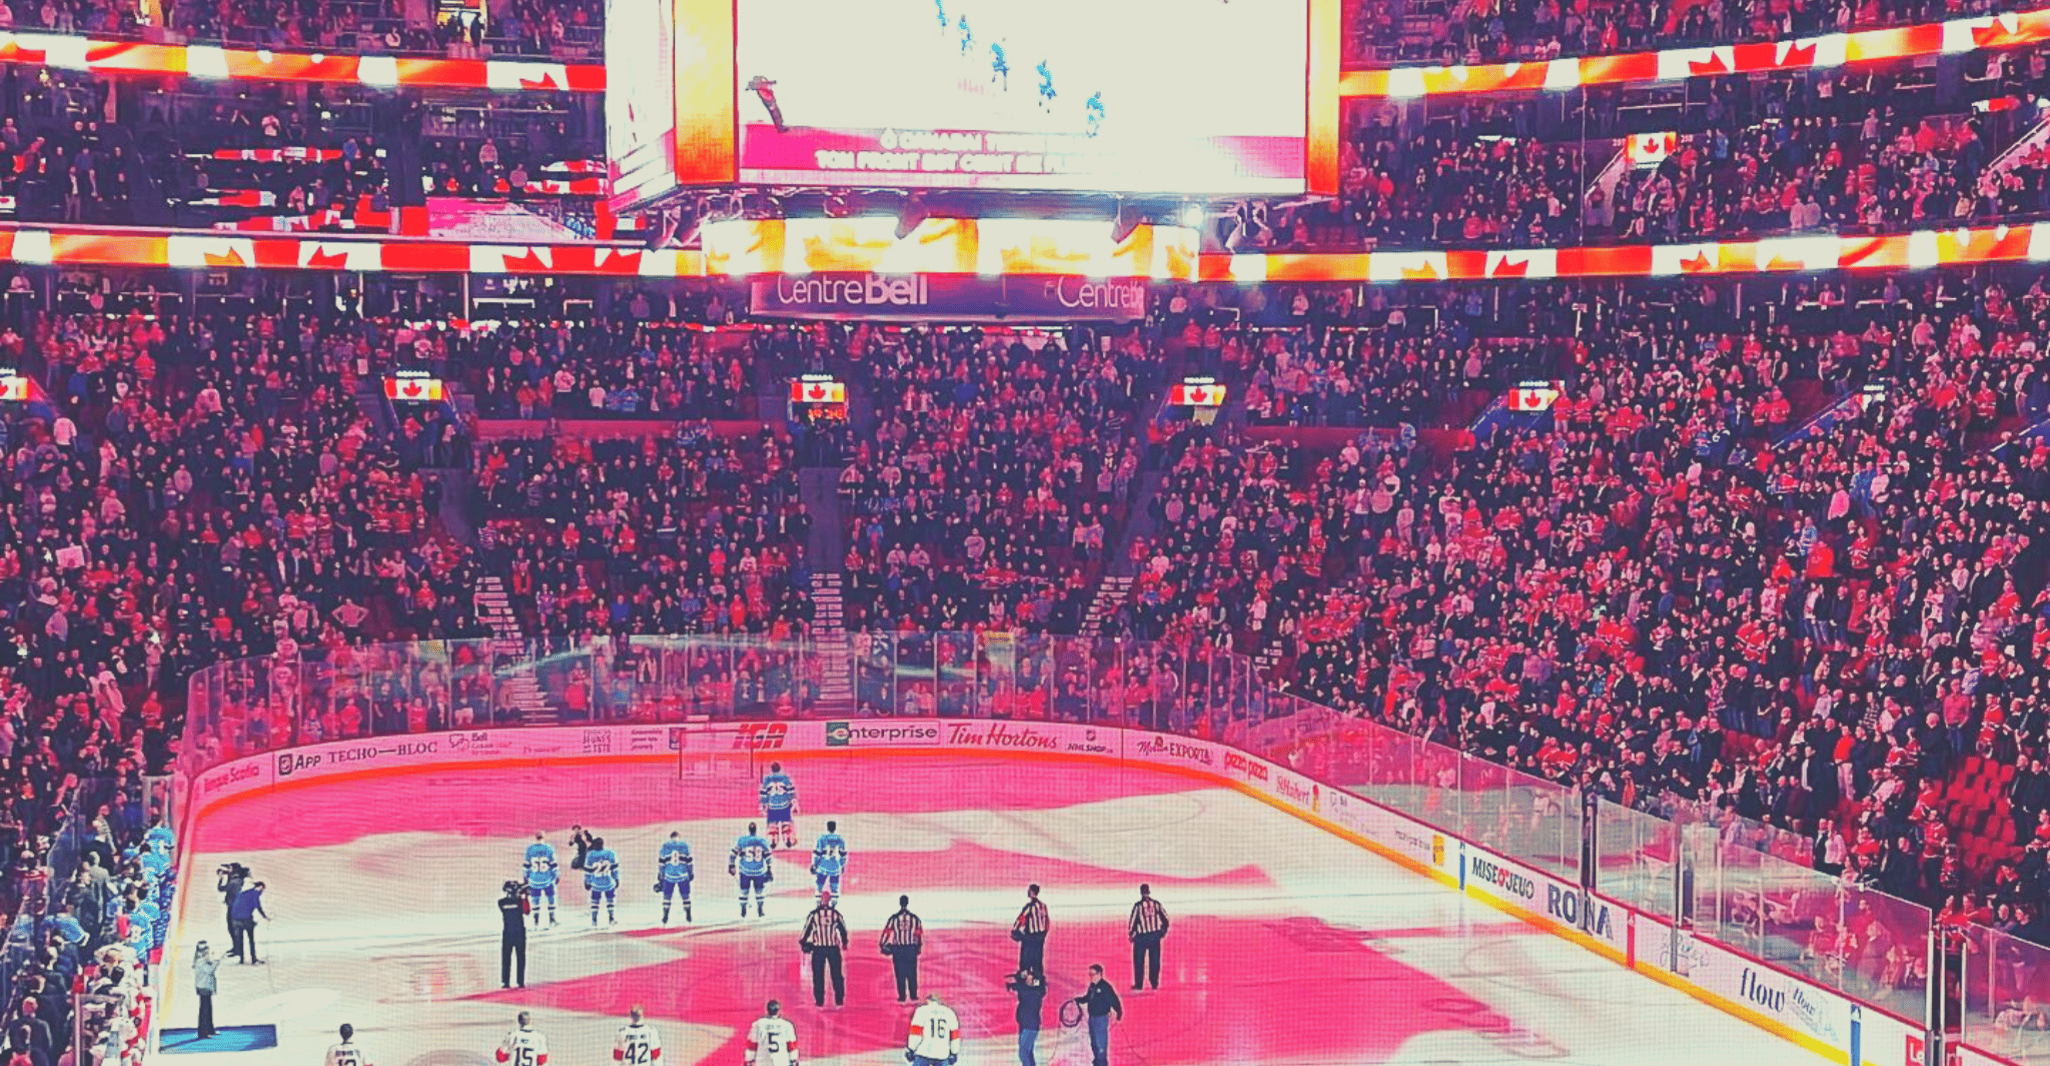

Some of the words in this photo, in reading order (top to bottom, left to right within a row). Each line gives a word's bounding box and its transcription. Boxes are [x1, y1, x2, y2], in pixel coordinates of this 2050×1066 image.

[833, 724, 938, 741] enterprise
[948, 722, 983, 745] Tim
[985, 722, 1058, 749] Hortons
[1740, 967, 1785, 1013] flow
[930, 1017, 947, 1039] 16
[624, 1042, 649, 1065] 42
[768, 1032, 780, 1053] 5
[514, 1046, 535, 1066] 15
